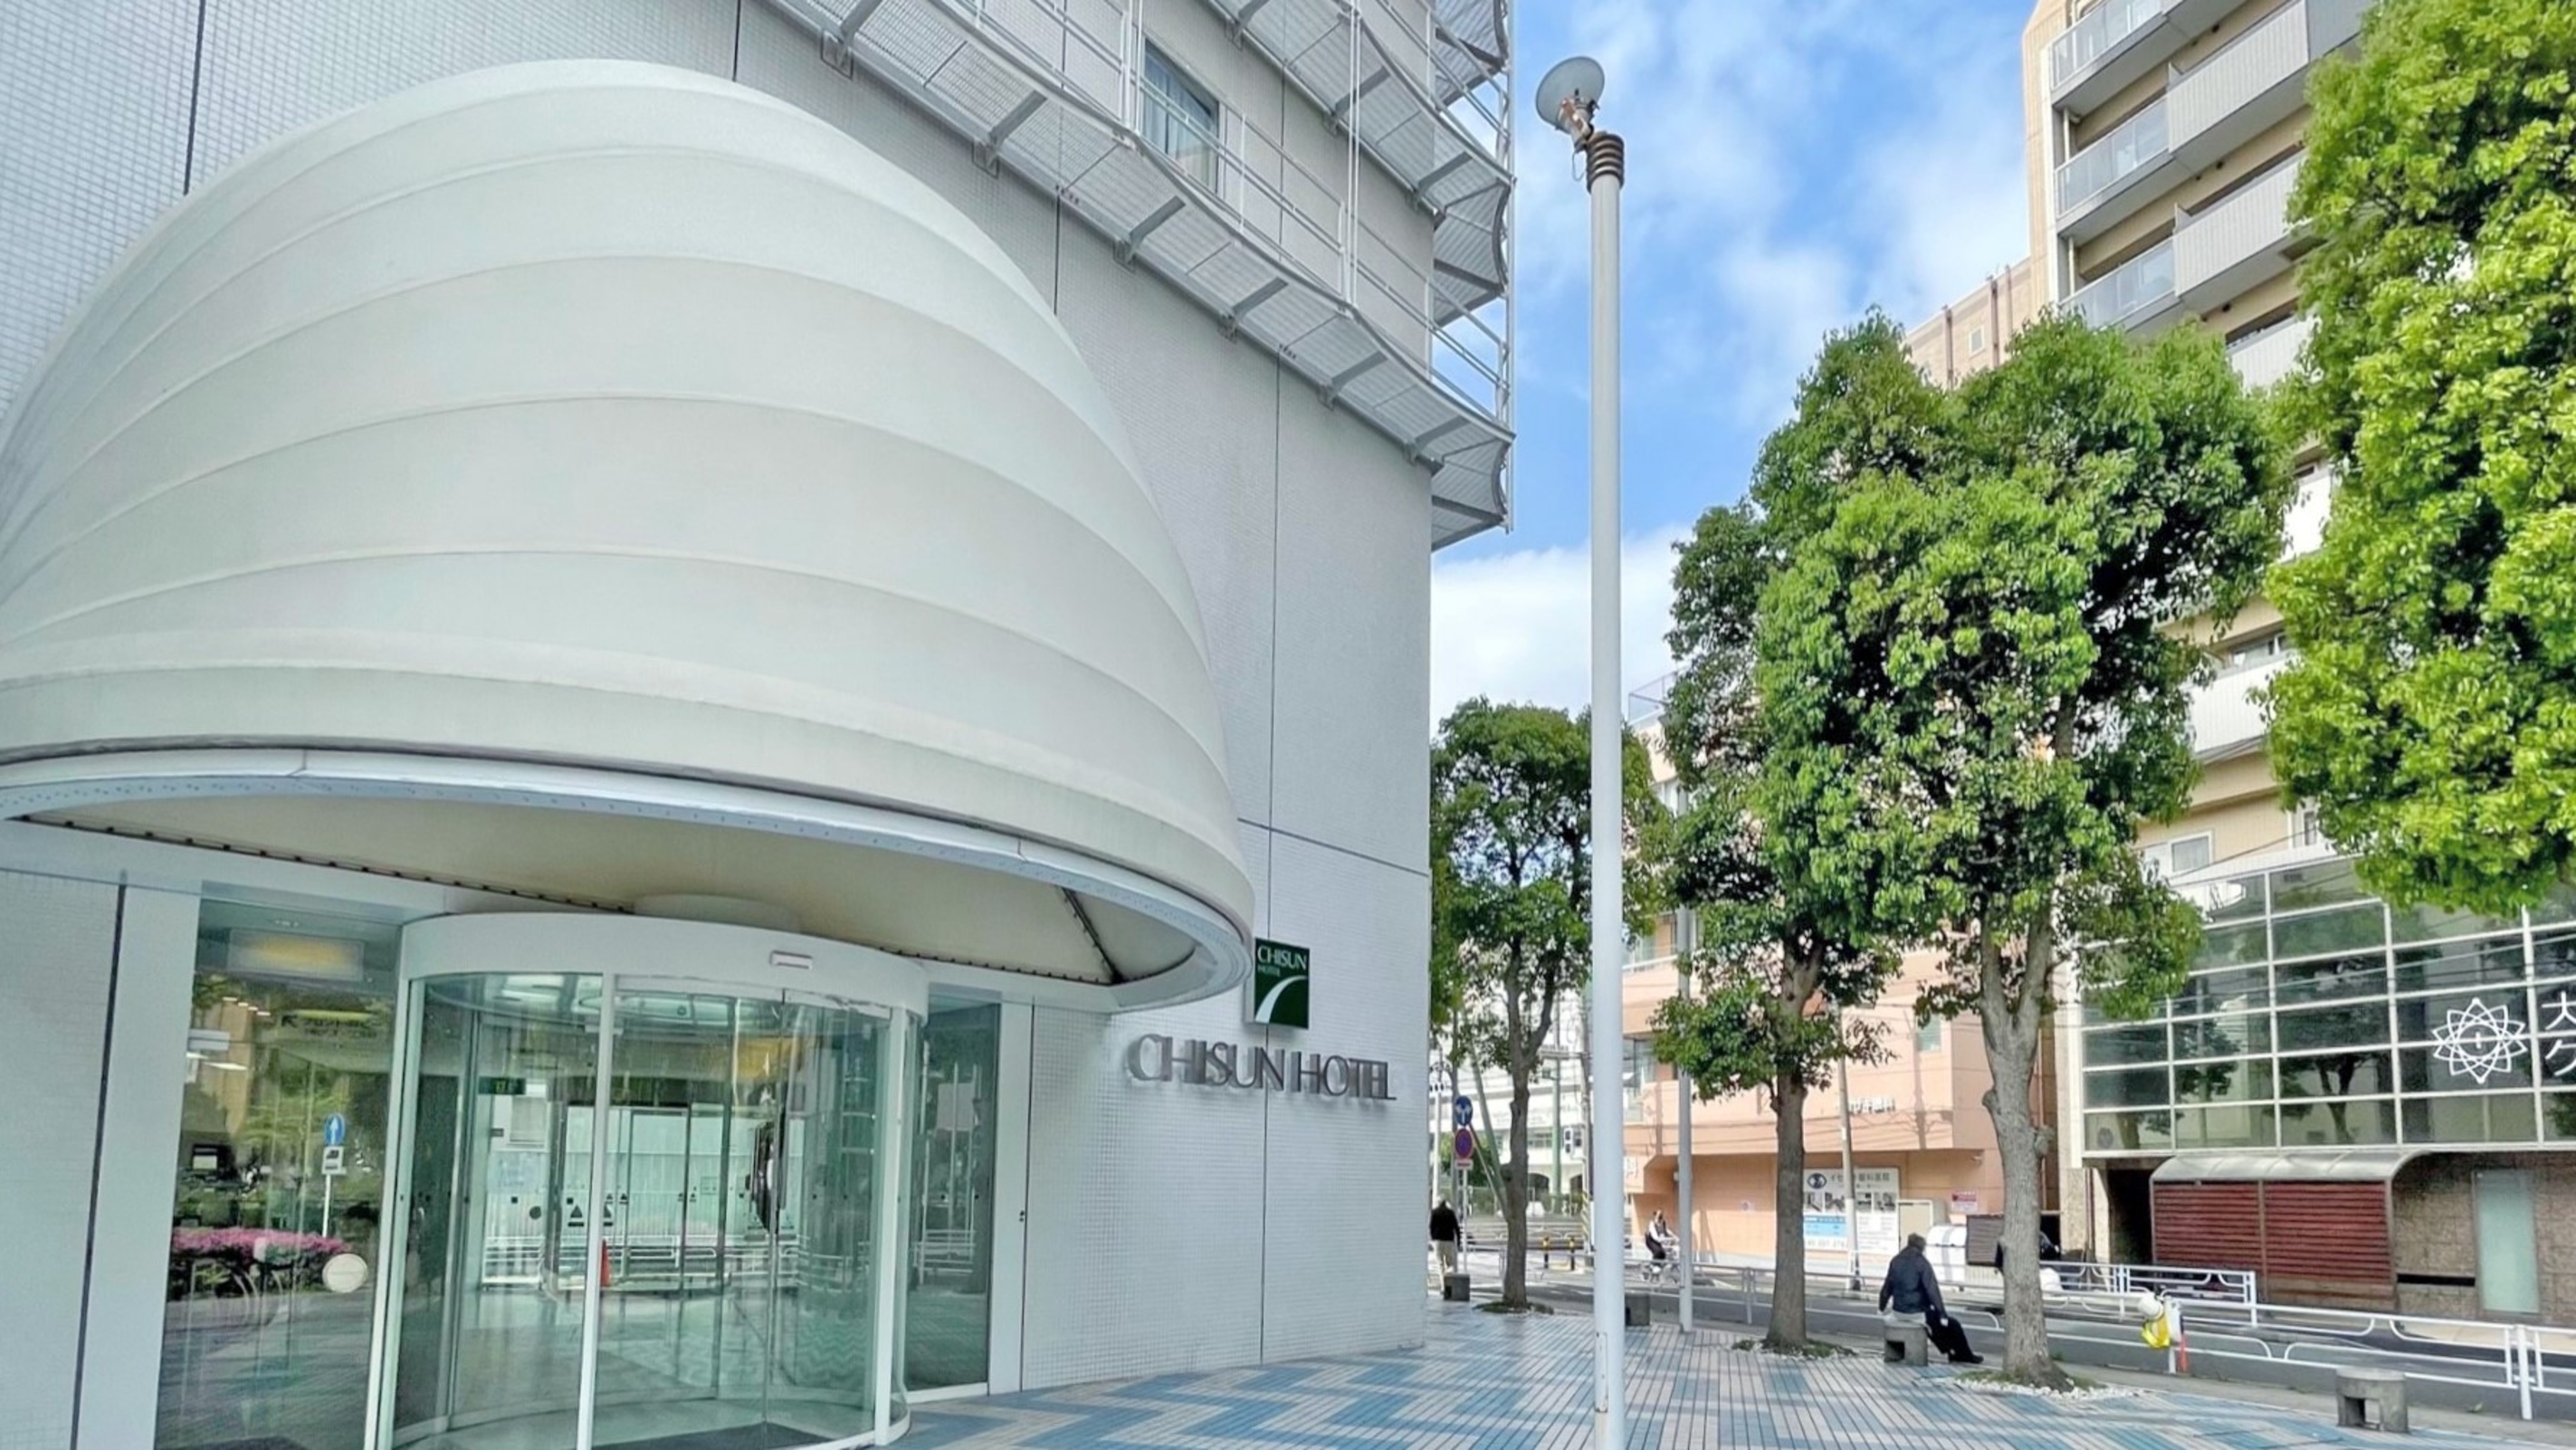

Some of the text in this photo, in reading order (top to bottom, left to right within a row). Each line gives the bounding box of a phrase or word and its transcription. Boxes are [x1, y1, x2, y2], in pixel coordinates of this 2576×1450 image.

[1257, 945, 1307, 970] CHISUN
[1127, 1034, 1397, 1101] CHISUN HOTEL
